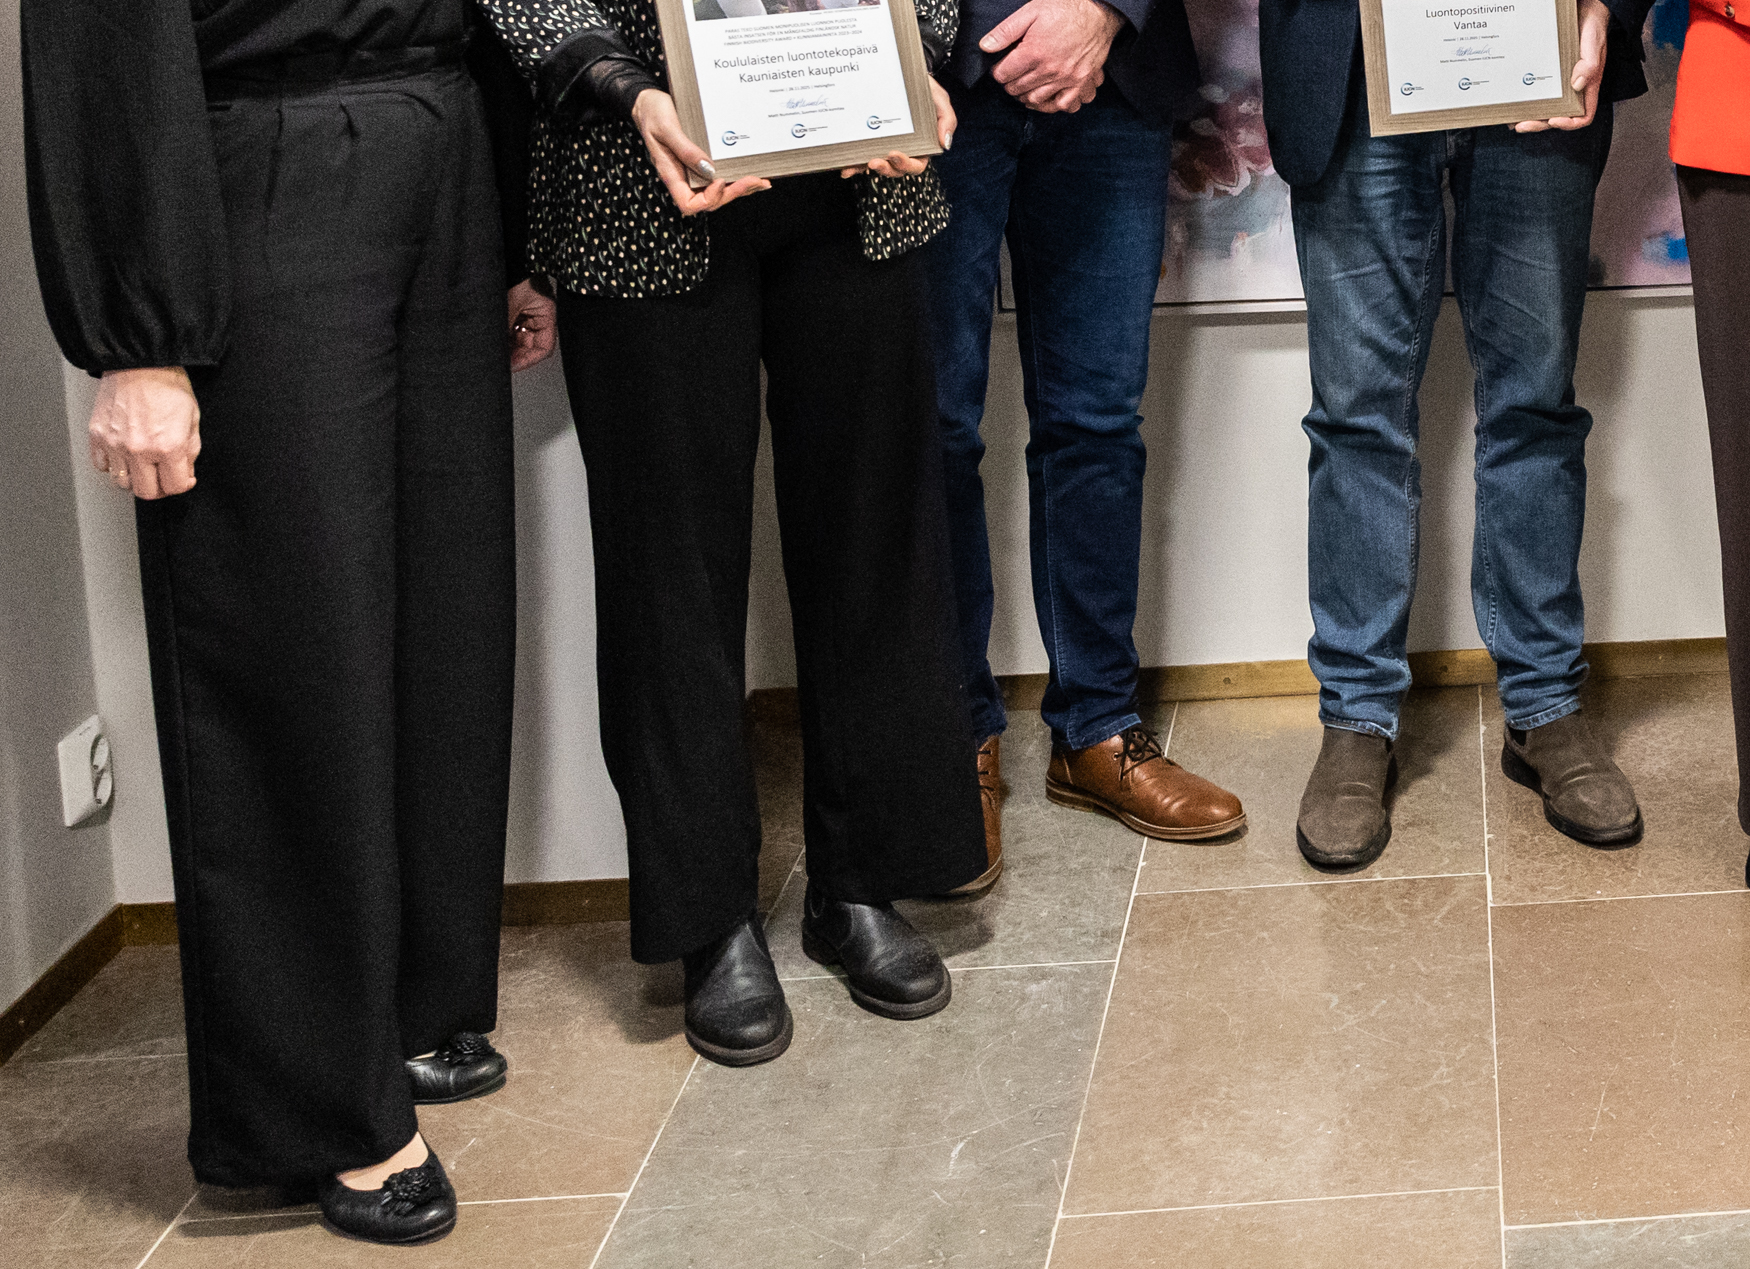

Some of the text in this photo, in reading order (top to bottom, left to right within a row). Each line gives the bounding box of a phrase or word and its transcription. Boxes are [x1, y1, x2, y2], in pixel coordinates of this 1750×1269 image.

[1425, 4, 1515, 18] Luontopositiivinen
[1453, 21, 1488, 30] Vantaa
[714, 44, 878, 69] Koululaisten luontotekopäivä
[739, 62, 859, 83] Kauniaisten kaupunki
